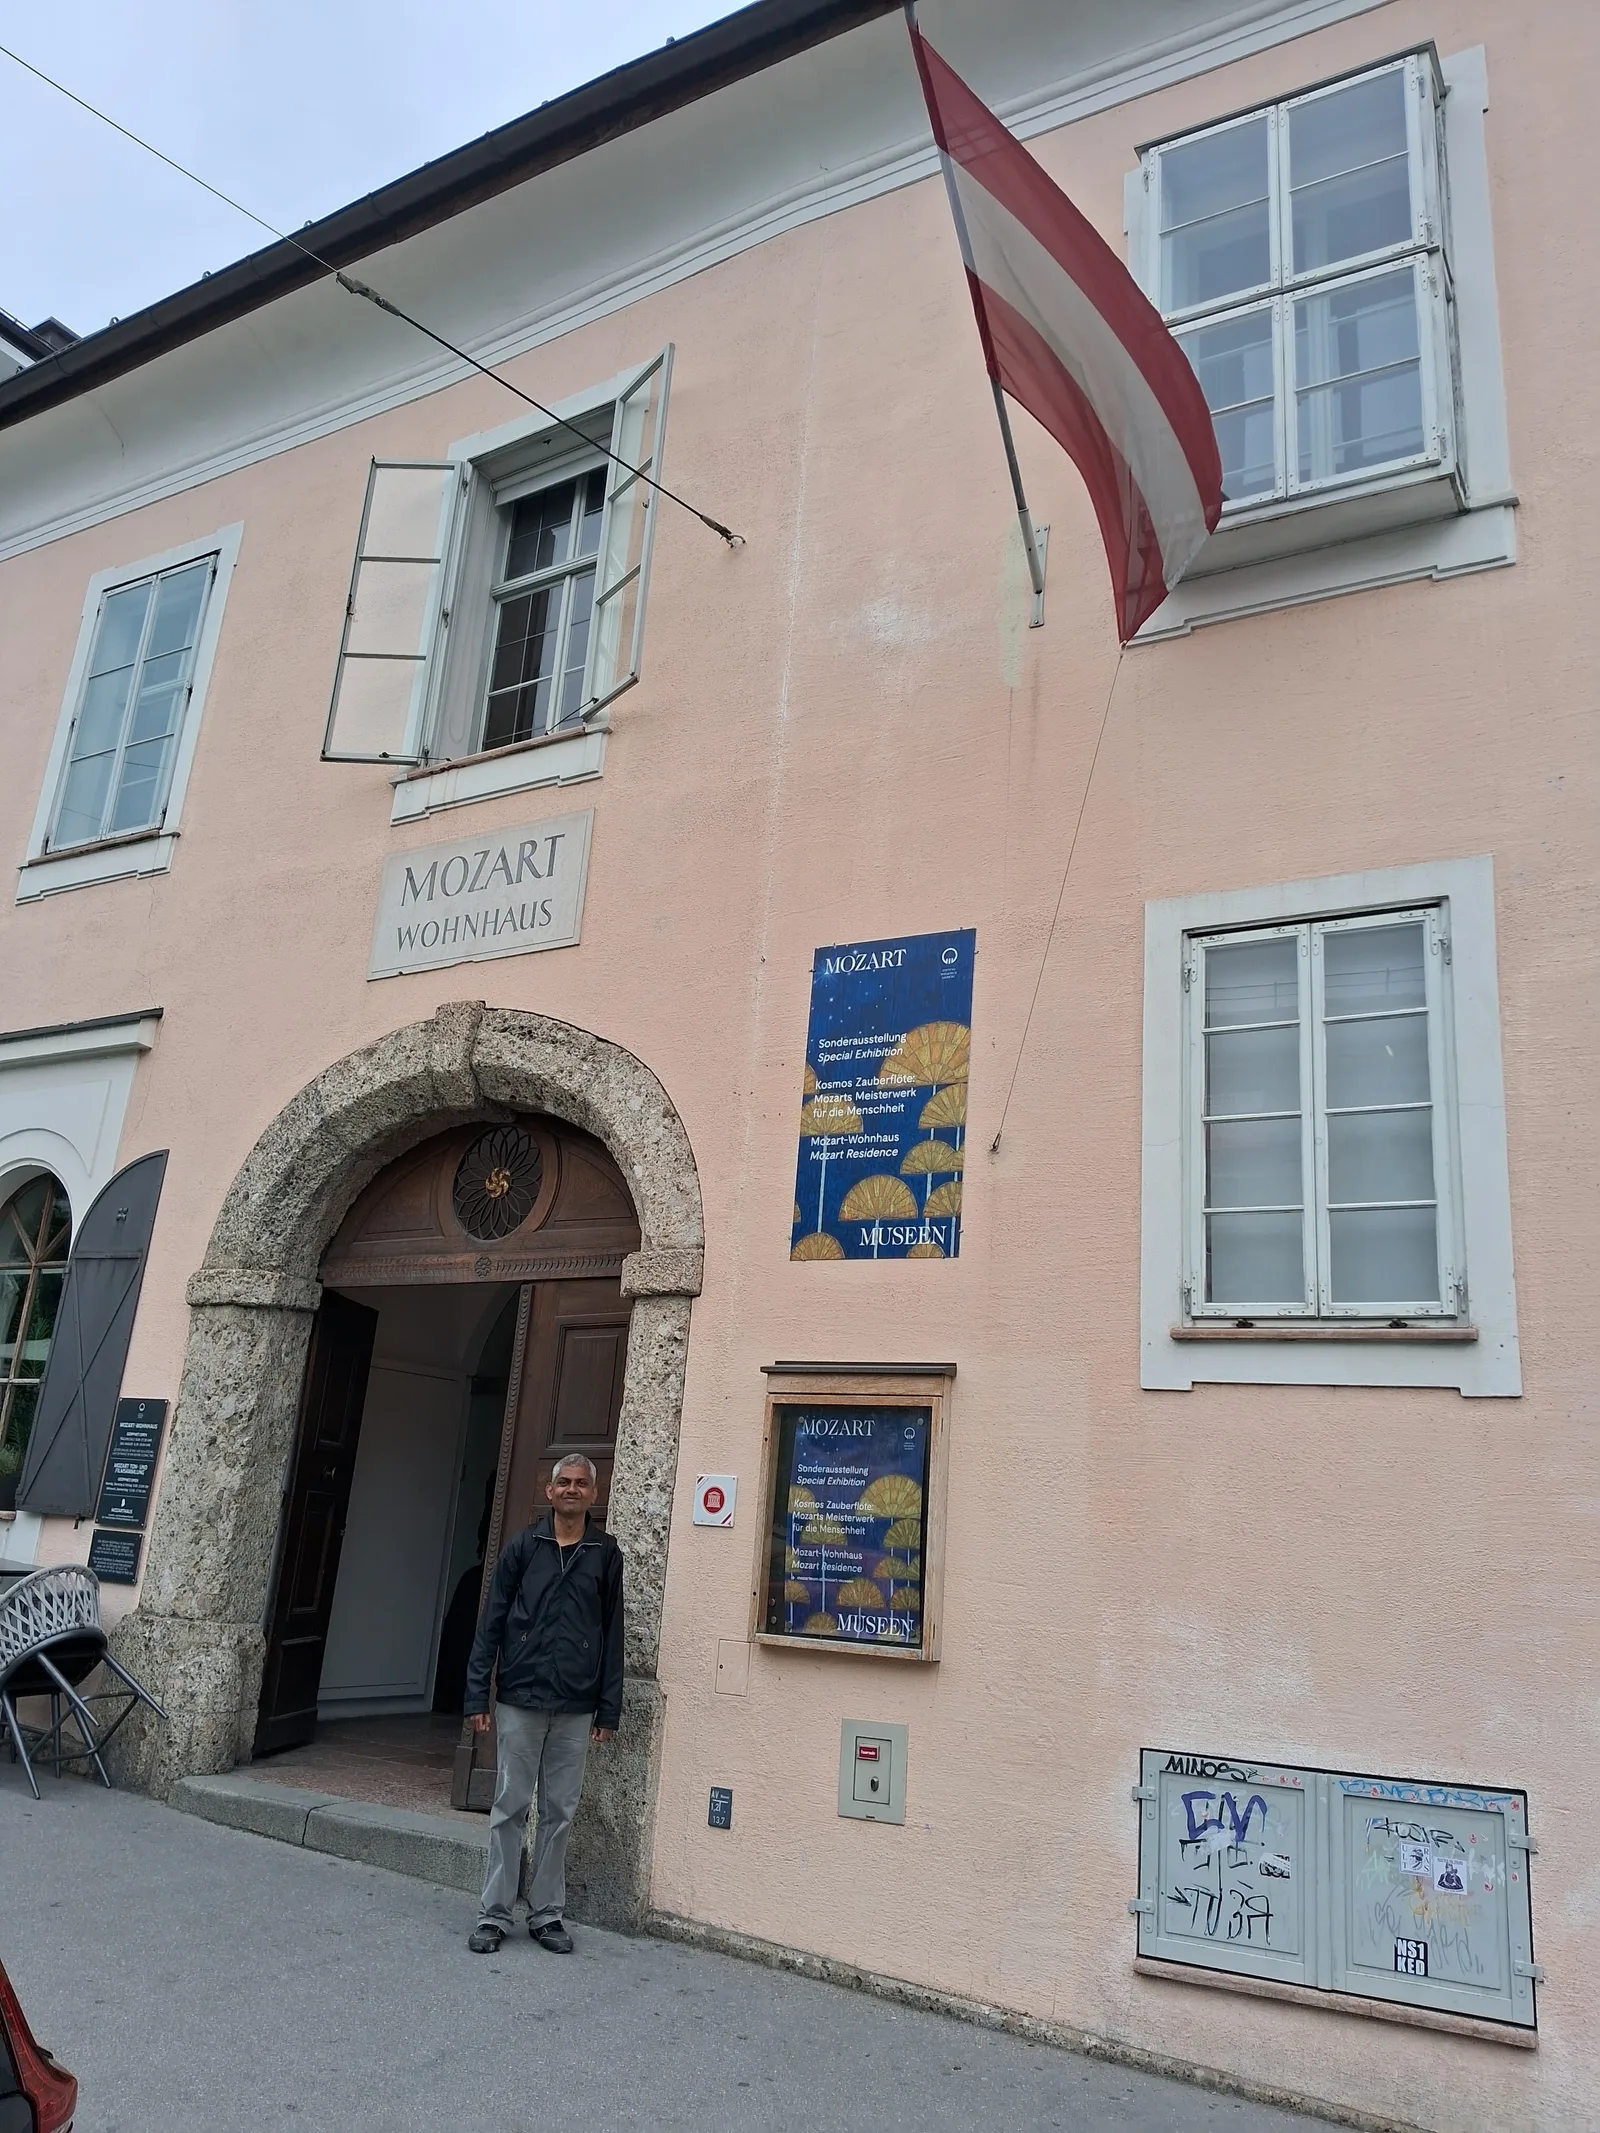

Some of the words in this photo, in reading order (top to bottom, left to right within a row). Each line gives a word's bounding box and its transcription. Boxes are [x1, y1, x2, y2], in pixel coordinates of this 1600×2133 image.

[400, 833, 566, 907] MOZART
[396, 898, 553, 952] WOHNHAUS
[824, 949, 907, 975] MOZART
[818, 1032, 907, 1049] Sonderausstellung
[817, 1050, 853, 1064] Special
[855, 1047, 903, 1060] Exhibition
[815, 1079, 853, 1091] Kosmos
[855, 1074, 916, 1087] Zauberflöte:
[814, 1092, 853, 1104] Mozarts
[855, 1088, 917, 1101] Meisterwerk
[813, 1107, 827, 1118] für
[828, 1106, 844, 1117] die
[846, 1103, 905, 1116] Menschheit
[810, 1131, 900, 1147] Mozart-Wohnhaus
[809, 1150, 844, 1161] Mozart
[846, 1148, 899, 1159] Residence
[859, 1225, 947, 1246] MUSEEN
[802, 1418, 876, 1437] MOZART
[797, 1464, 869, 1477] Sonderausstellung
[796, 1475, 826, 1486] Special
[827, 1477, 866, 1487] Exhibition
[793, 1499, 825, 1509] Kosmos
[826, 1500, 874, 1511] Zauberflöte:
[792, 1512, 824, 1522] Mozarts
[825, 1513, 875, 1524] Meisterwerk
[792, 1522, 804, 1532] für
[805, 1523, 818, 1533] die
[819, 1524, 866, 1536] Menschheit
[791, 1547, 863, 1560] Mozart-Wohnhaus
[791, 1559, 820, 1570] Mozart
[821, 1561, 863, 1573] Residence
[836, 1613, 915, 1637] MUSEEN
[1397, 1956, 1426, 1977] KED
